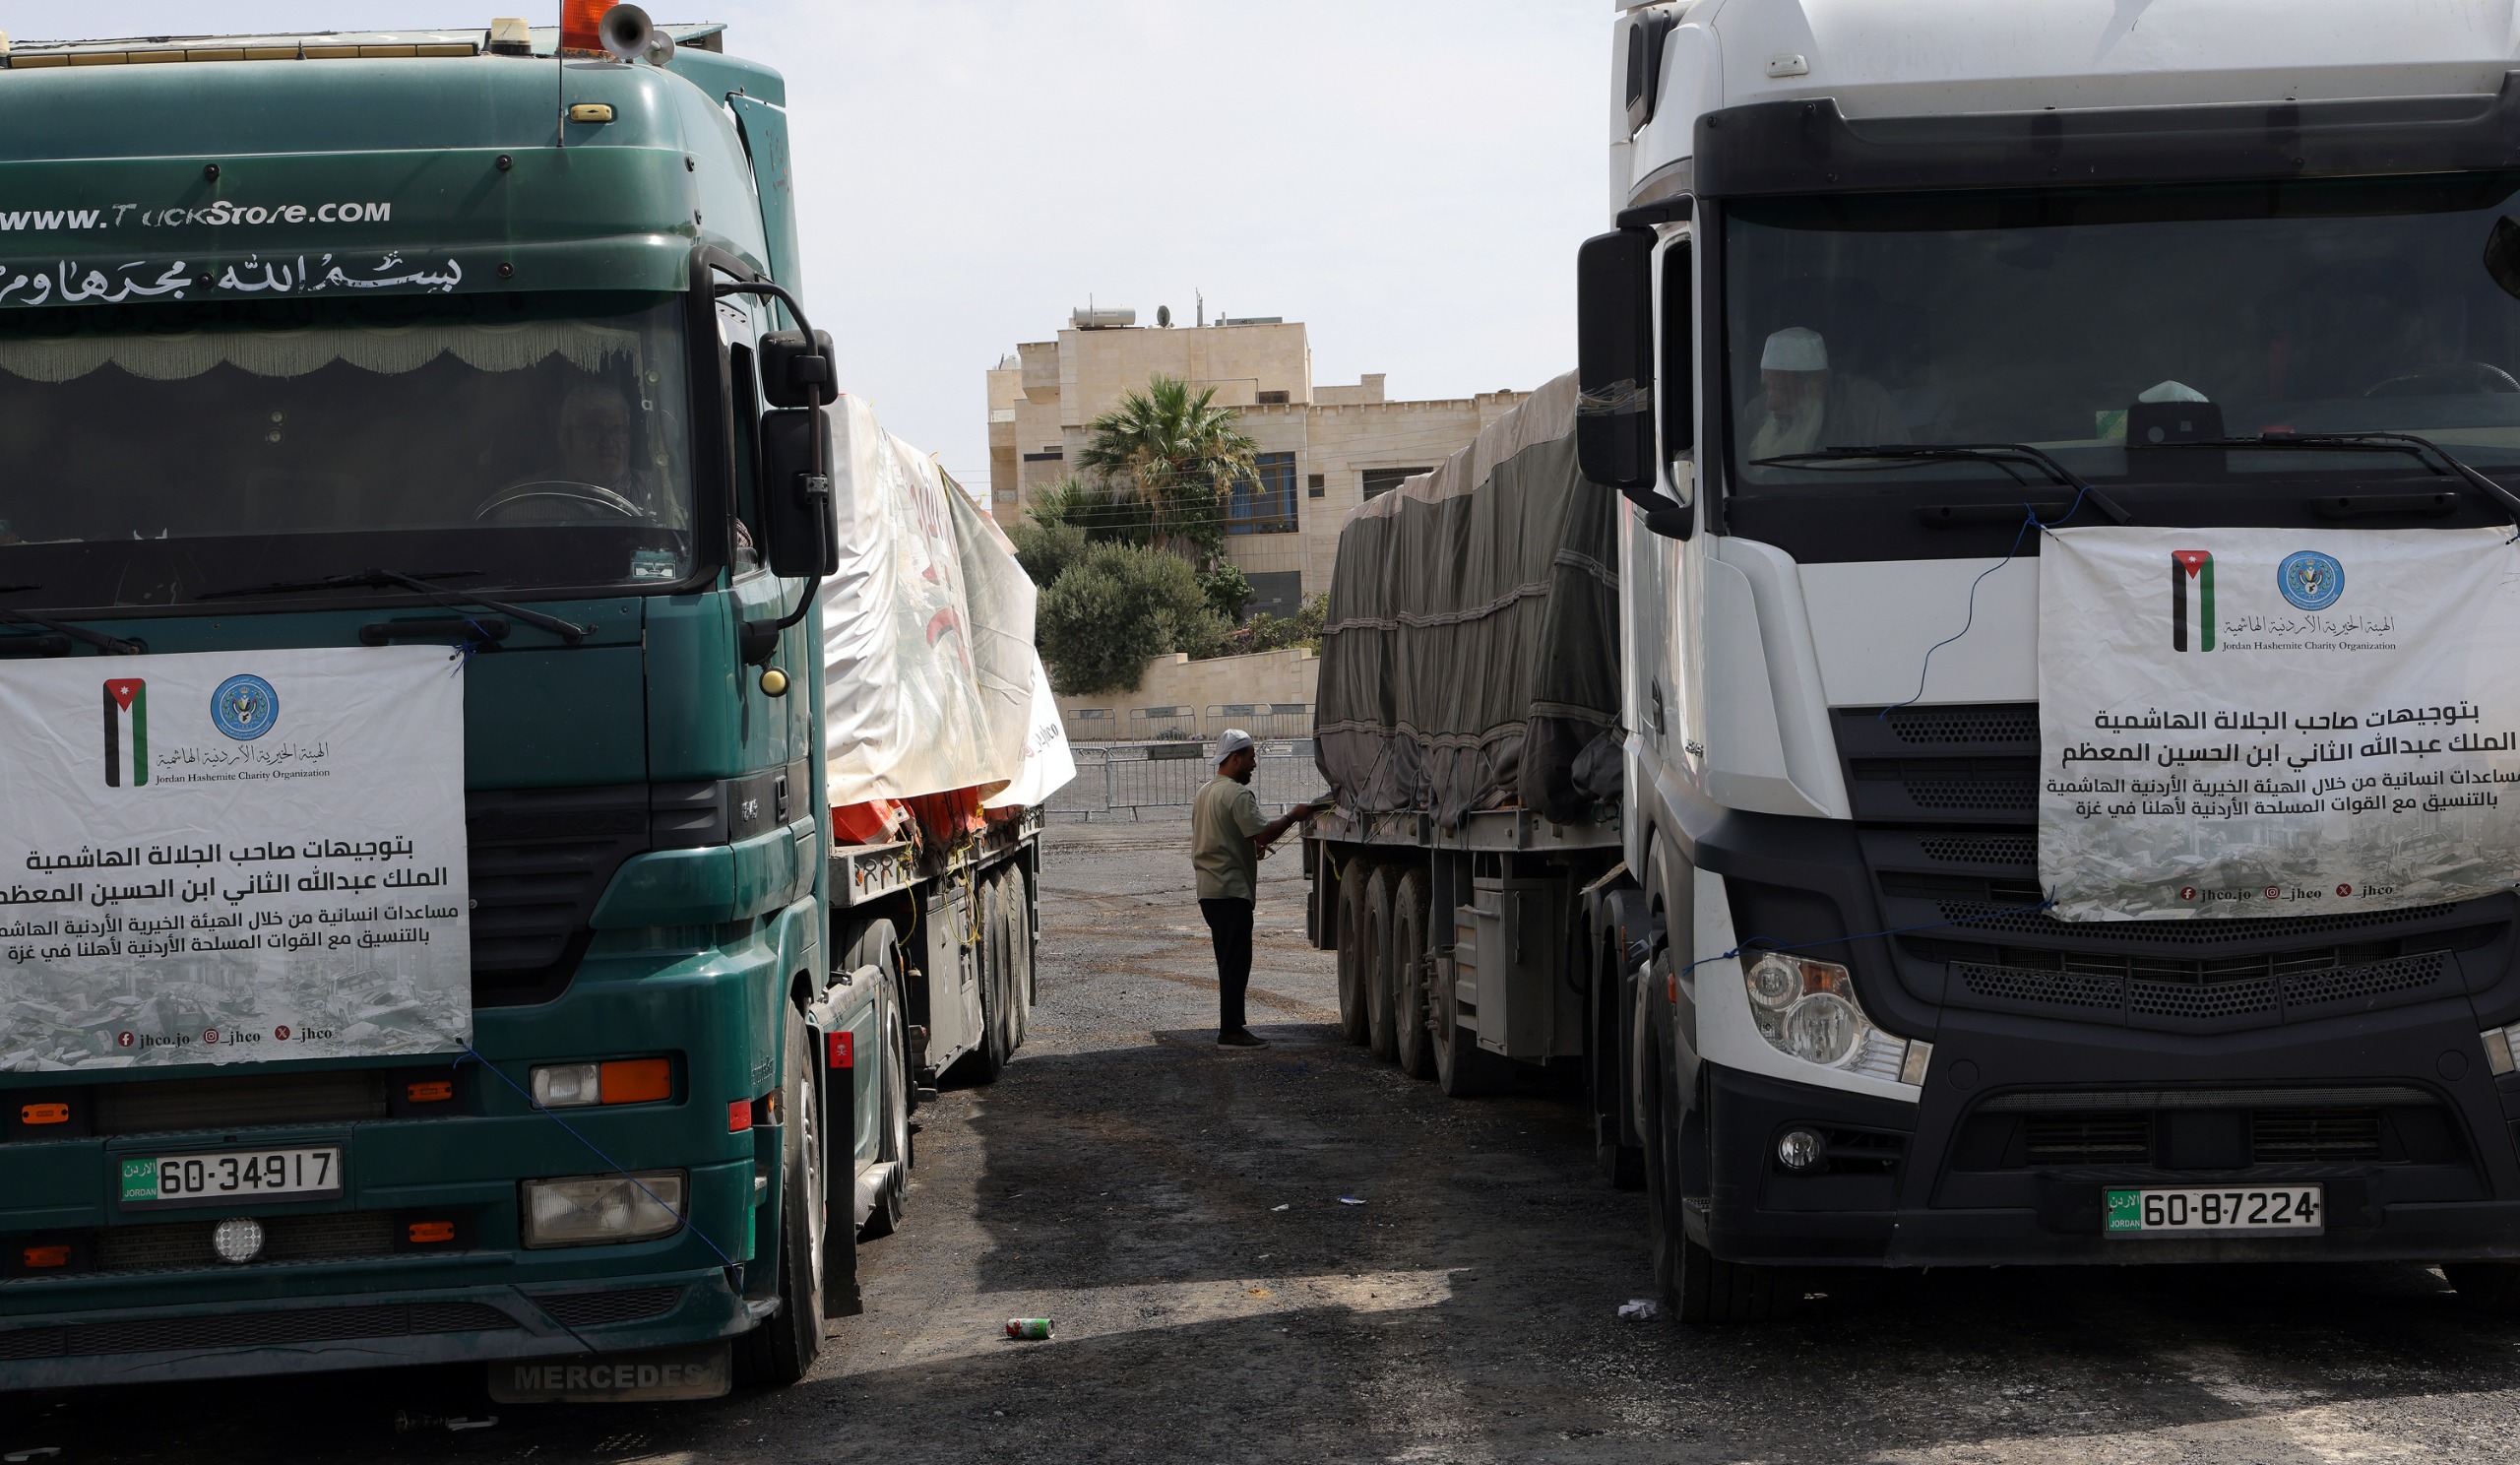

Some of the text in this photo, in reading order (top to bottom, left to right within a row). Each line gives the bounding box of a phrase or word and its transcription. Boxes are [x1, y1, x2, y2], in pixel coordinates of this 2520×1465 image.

[217, 253, 307, 293] الله
[2222, 614, 2266, 637] الهاشمية
[2322, 614, 2362, 638] الخيرية
[2364, 615, 2395, 637] الهيئة
[2222, 641, 2396, 654] Jordan Hashemite Charity Organization
[2094, 700, 2480, 735] بتوجيهات صاحب الجلالة الهاشمية
[298, 741, 330, 763] الهيئة
[2448, 732, 2516, 752] الملك
[156, 746, 200, 770] الهاشمية
[256, 742, 297, 766] الخيرية
[2061, 741, 2150, 769] المعظم
[2157, 742, 2239, 767] الحسين
[2245, 742, 2280, 767] ابن
[2287, 740, 2353, 773] الثاني
[156, 769, 331, 786] Jordan Hashemite Charity Organization
[2046, 777, 2125, 796] الهاشمية
[2130, 775, 2187, 797] الأردنية
[2192, 778, 2249, 797] الخيرية
[2253, 776, 2305, 797] الهيئة
[2311, 777, 2347, 796] خلال
[2351, 775, 2376, 792] من
[2449, 768, 2520, 785] ساعدات
[2075, 792, 2498, 820] بالتنسيق مع القوات المسلحة الأردنية لأهلنا في غزة
[26, 835, 413, 875] بتوجيهات صاحب الجلالة الهاشمية
[222, 870, 290, 907] الثاني
[382, 866, 448, 889] الملك
[91, 878, 174, 907] الحسين
[181, 876, 216, 903] ابن
[2200, 888, 2252, 904] jhco.jo
[190, 912, 243, 932] الهيئة
[248, 910, 284, 930] خلال
[287, 912, 313, 928] من
[383, 904, 459, 921] مساعدات
[0, 920, 59, 937] الهاشم
[64, 913, 123, 938] الأردنية
[128, 915, 185, 935] الخيرية
[8, 927, 430, 965] بالتنسيق مع القوات المسلحة الأردنية لأهلنا في غزة
[138, 1032, 190, 1051] jhco.jo
[159, 1152, 332, 1194] 60-34917
[124, 1187, 157, 1198] JORDAN
[2144, 1192, 2314, 1226] 60-87224
[2110, 1219, 2141, 1229] JORDAN
[514, 1364, 705, 1390] MERCEDES
